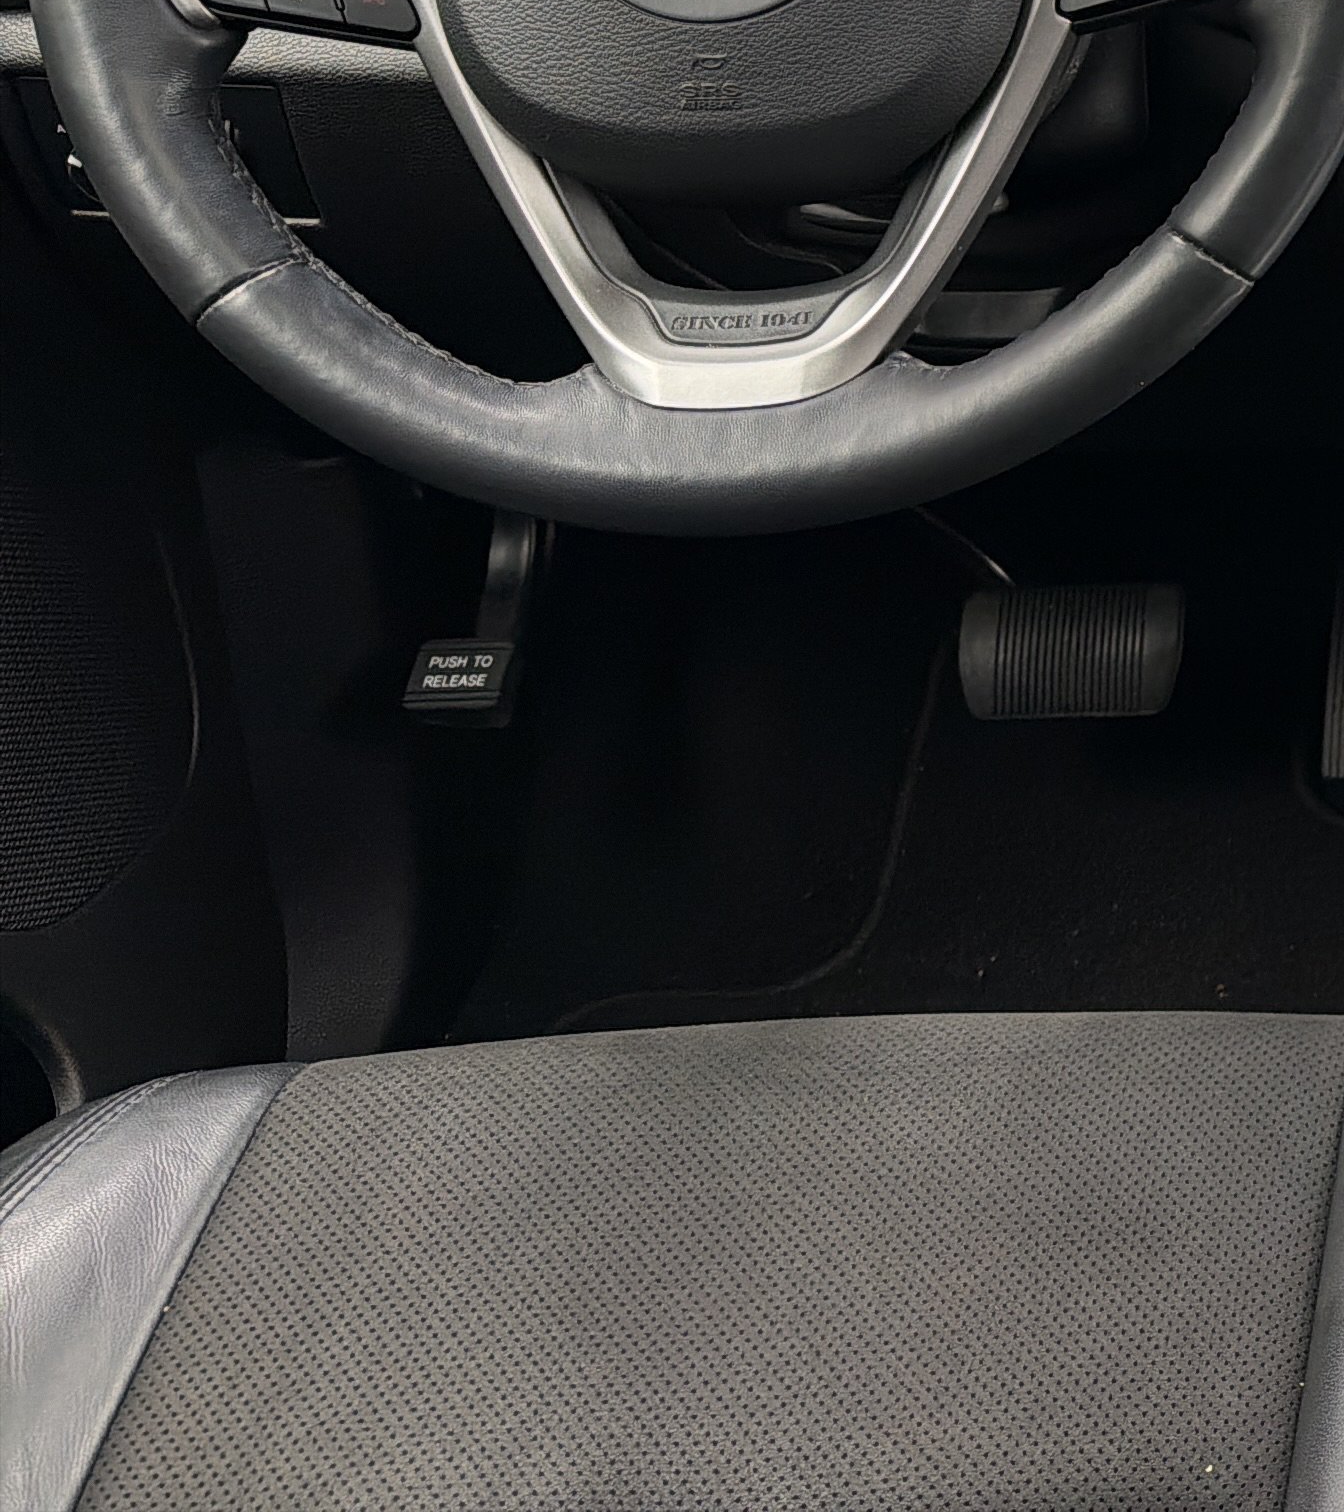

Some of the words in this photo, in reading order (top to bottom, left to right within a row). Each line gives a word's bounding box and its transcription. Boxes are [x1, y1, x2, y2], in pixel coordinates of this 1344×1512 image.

[671, 315, 751, 331] SINCE
[428, 655, 469, 669] PUSH
[474, 654, 494, 668] TO
[422, 673, 488, 688] RELEASE
